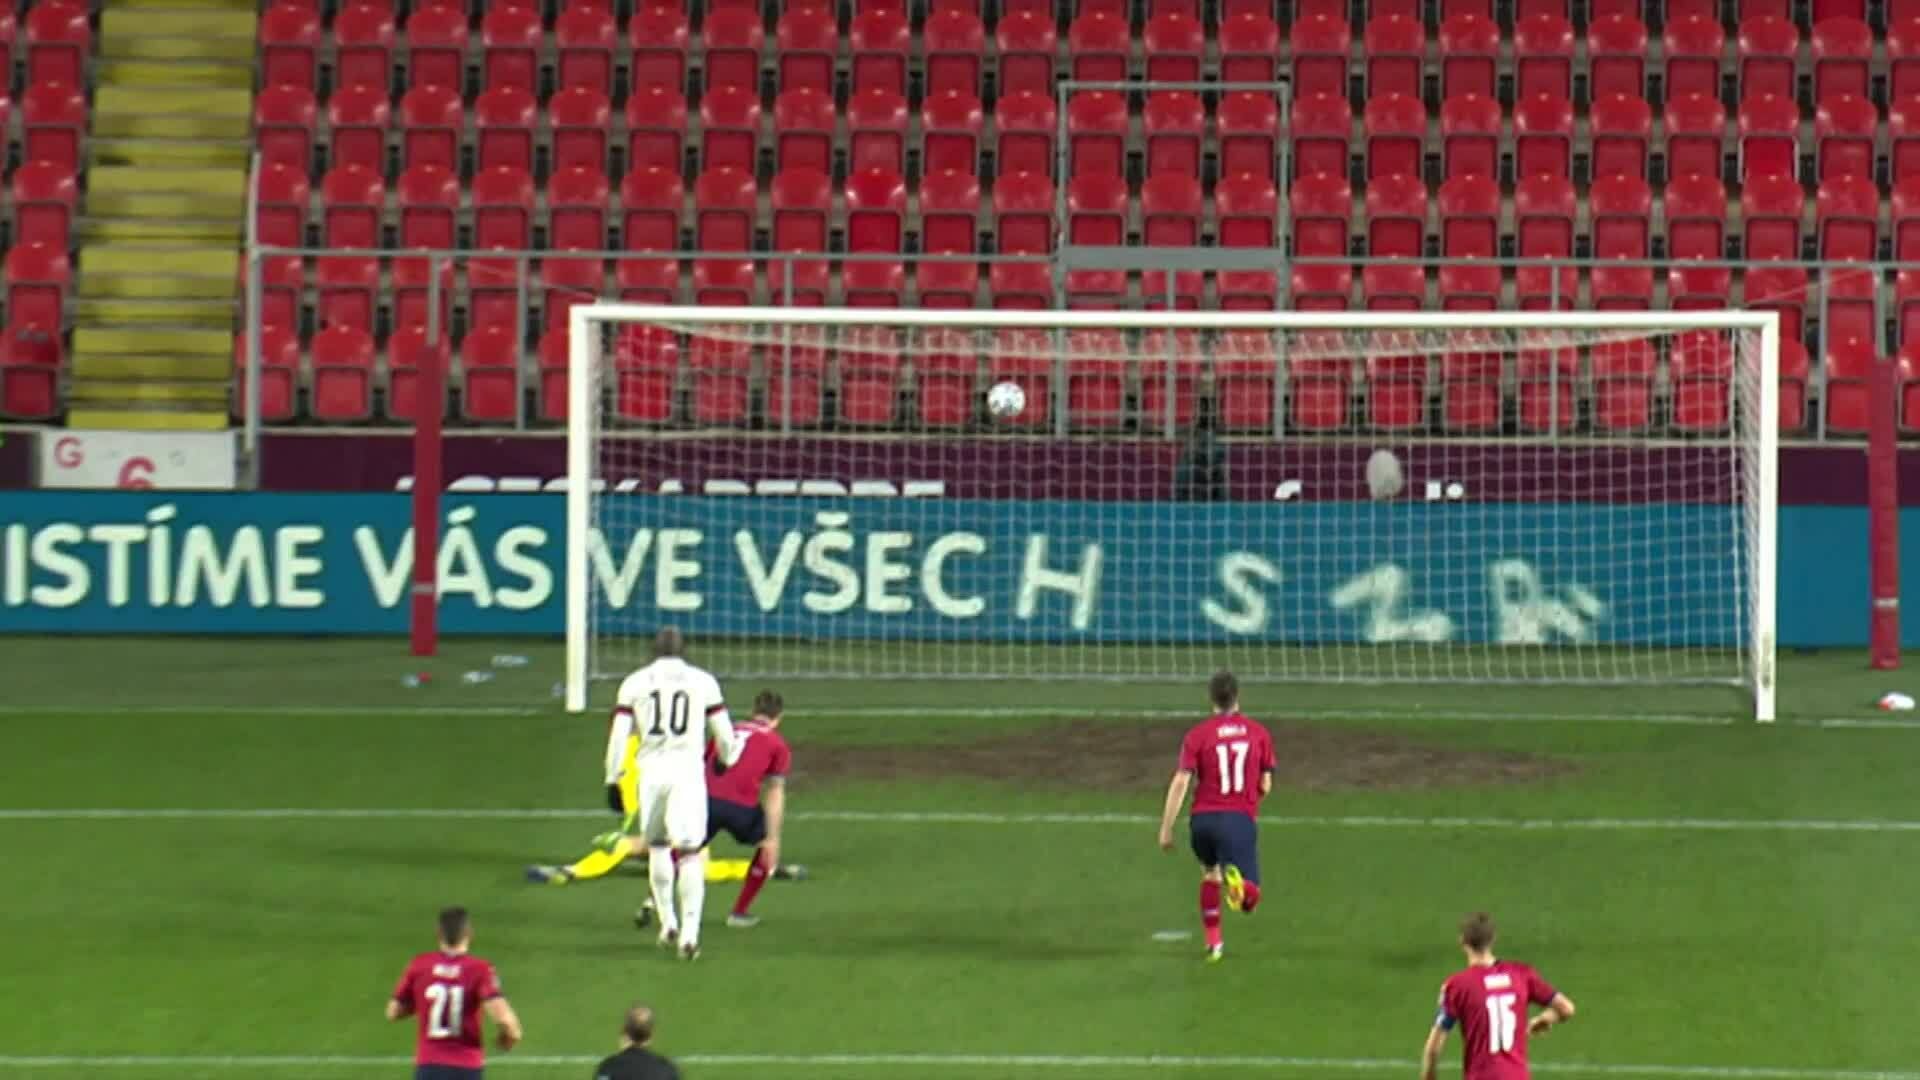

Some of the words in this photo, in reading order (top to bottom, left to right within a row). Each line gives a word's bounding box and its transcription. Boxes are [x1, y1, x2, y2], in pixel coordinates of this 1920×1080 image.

[54, 436, 84, 469] G
[354, 505, 553, 608] VÁS
[589, 527, 703, 610] VE
[648, 690, 690, 736] 10
[1216, 741, 1249, 795] 17
[424, 982, 464, 1039] 21
[1486, 994, 1517, 1055] 15
